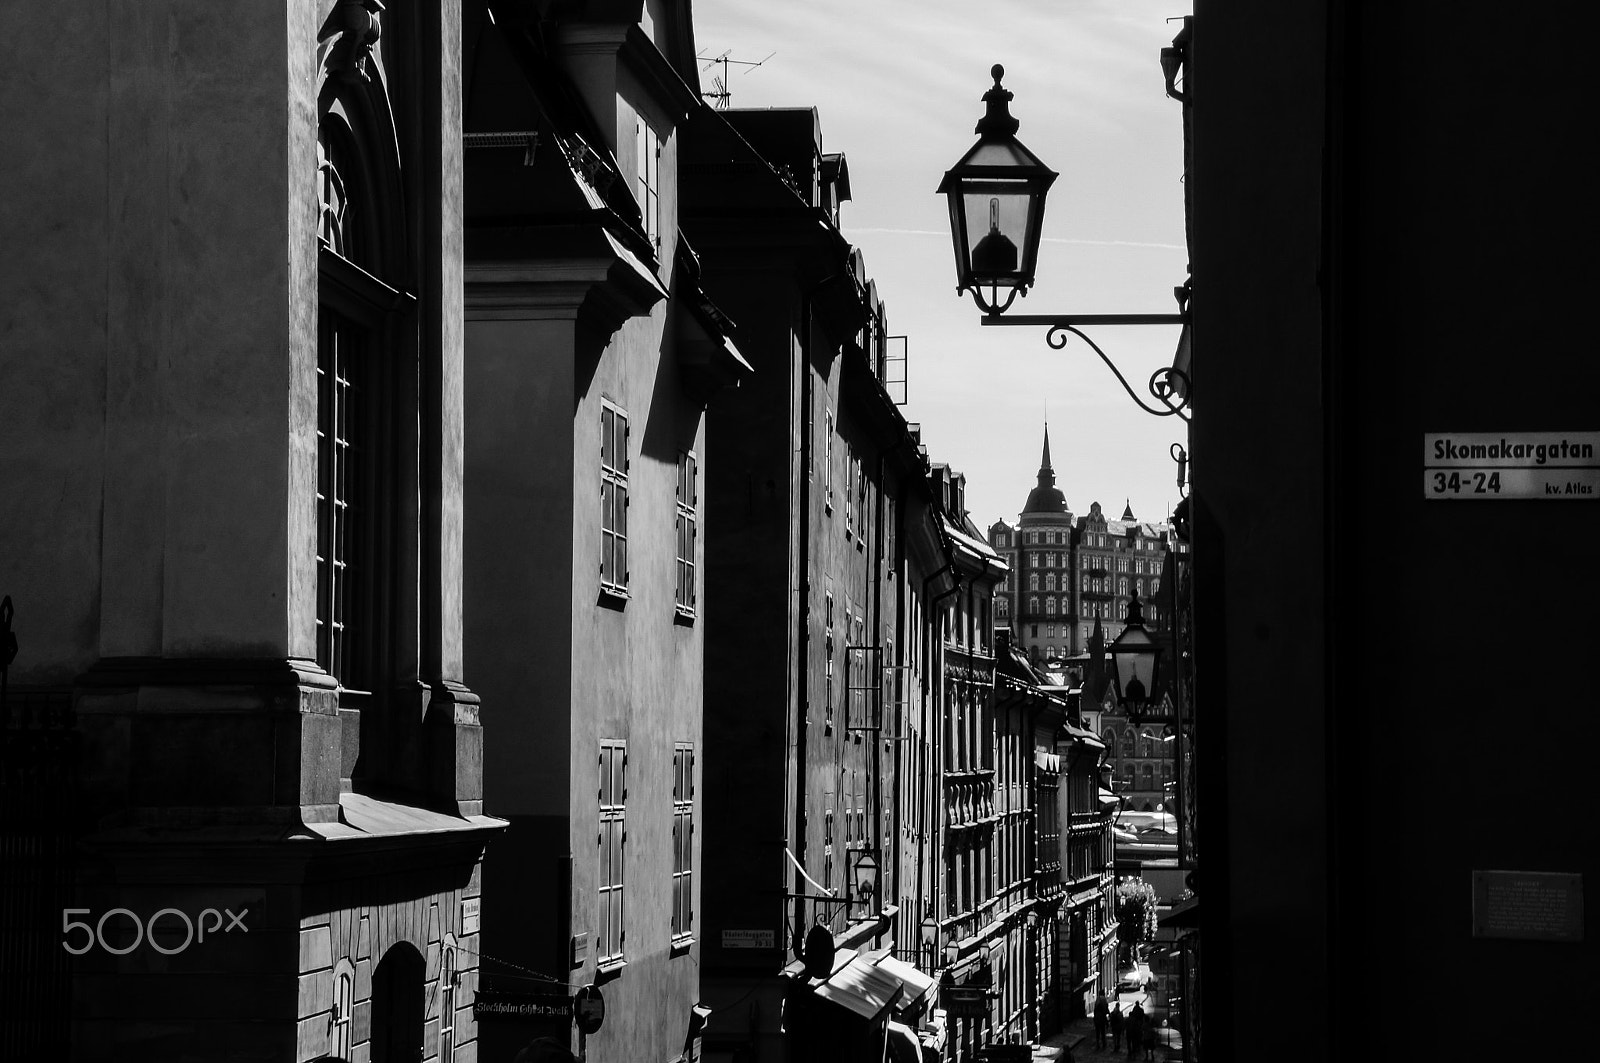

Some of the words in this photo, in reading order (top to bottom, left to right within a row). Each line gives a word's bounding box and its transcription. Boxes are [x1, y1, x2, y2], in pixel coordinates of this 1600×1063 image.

[1434, 438, 1593, 465] Skomakargatan
[1433, 472, 1501, 494] 34-24
[1545, 482, 1562, 494] kv.
[1565, 482, 1592, 495] Atlas
[474, 1001, 518, 1015] Stockholm
